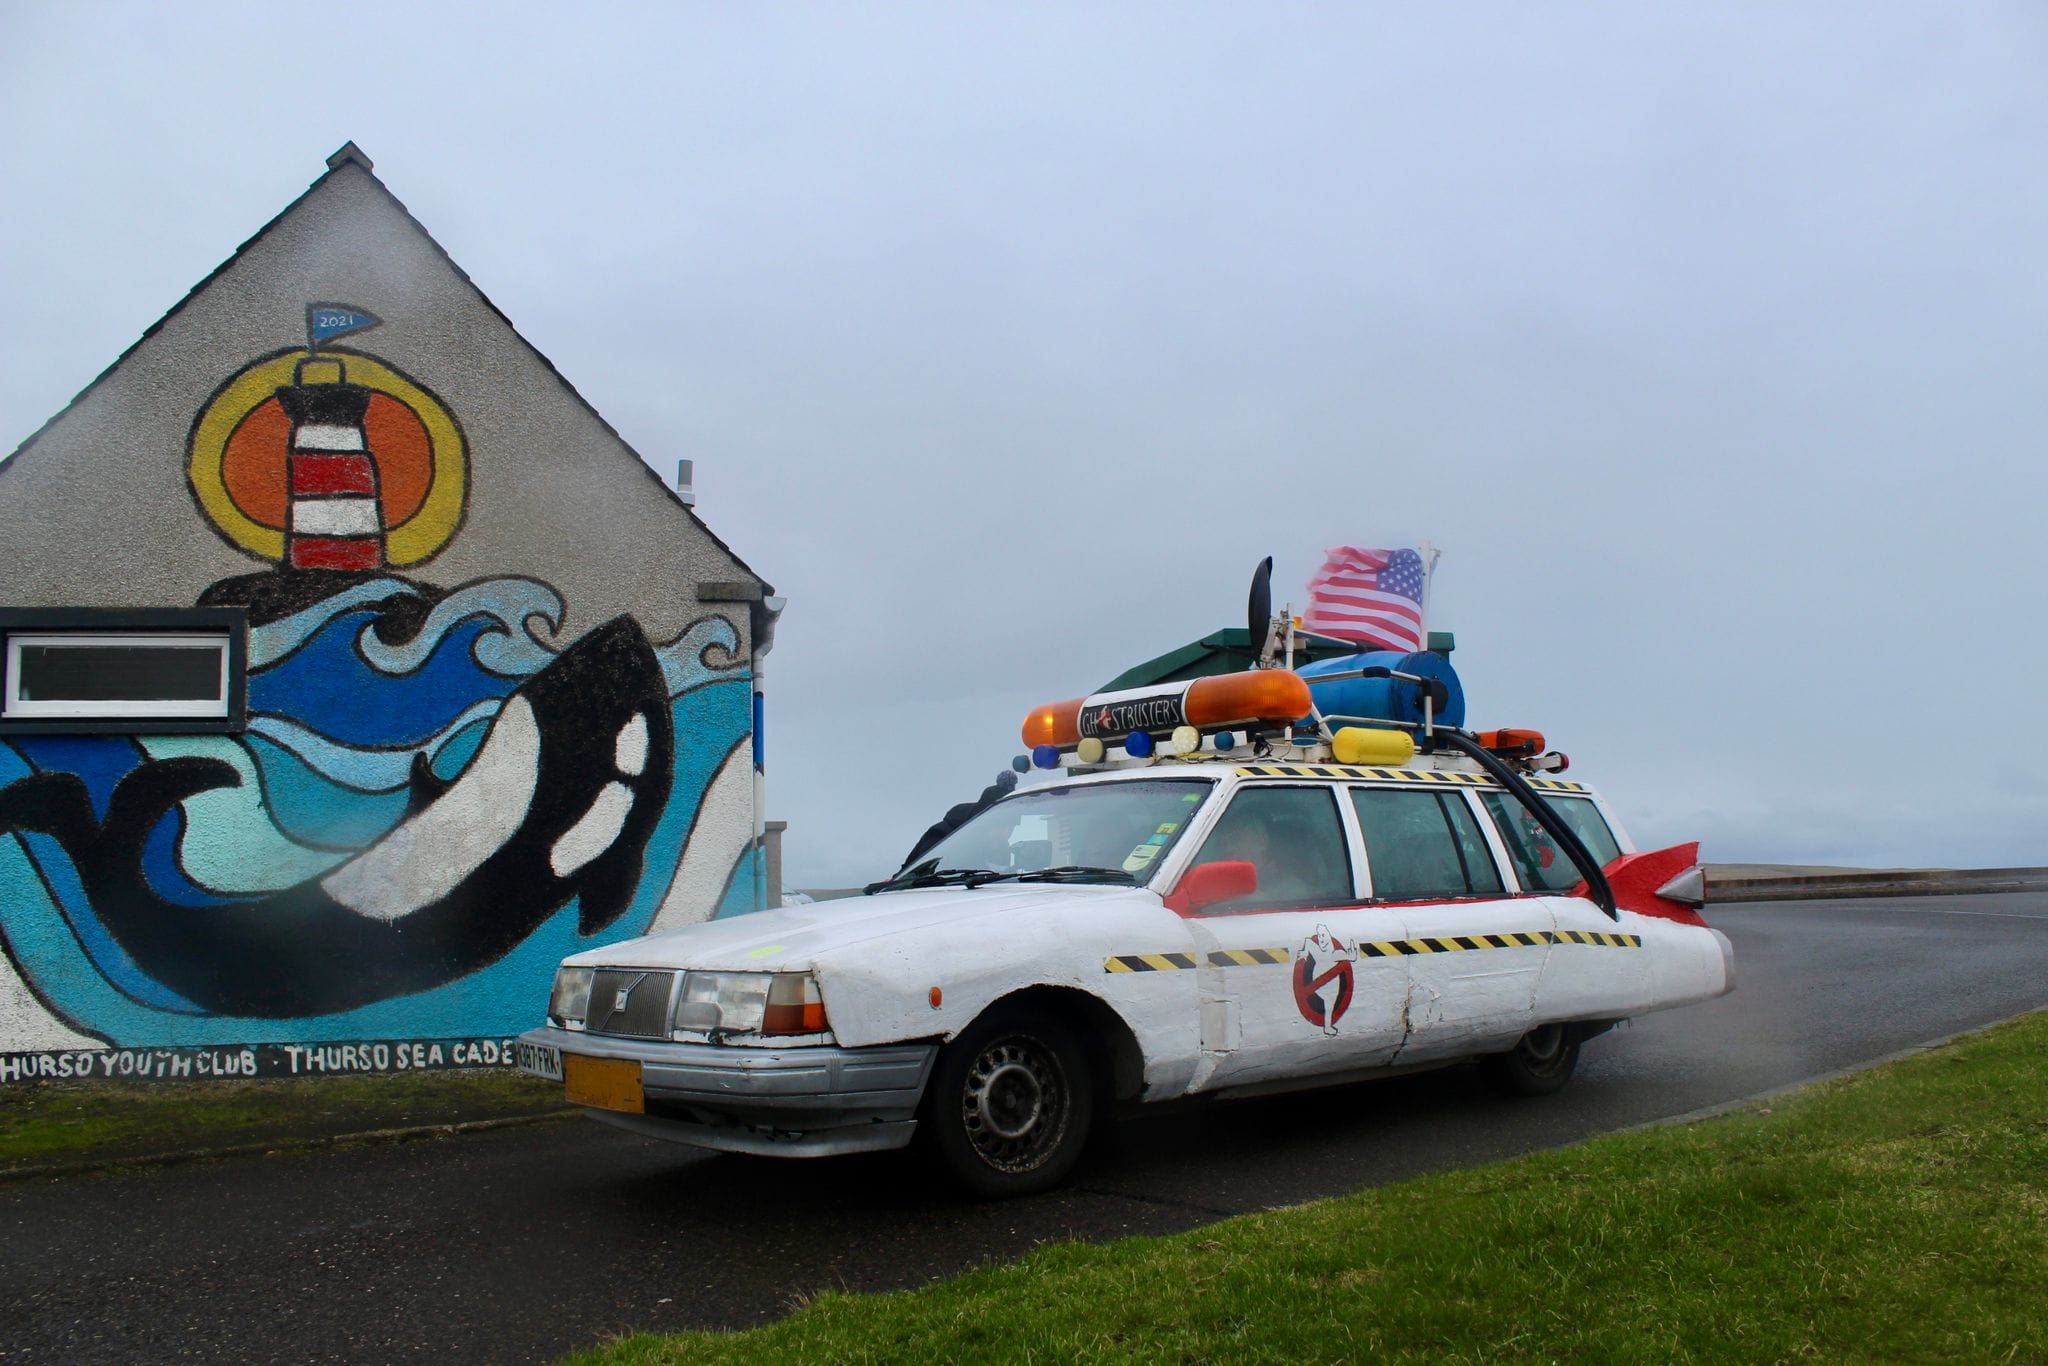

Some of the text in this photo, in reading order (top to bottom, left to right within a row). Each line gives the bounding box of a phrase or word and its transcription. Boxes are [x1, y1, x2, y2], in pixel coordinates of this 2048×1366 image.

[320, 314, 354, 327] 2021
[100, 1050, 191, 1077] YOUTH
[196, 1050, 258, 1076] CLUB
[284, 1043, 390, 1073] THURSO
[396, 1043, 443, 1070] SEA
